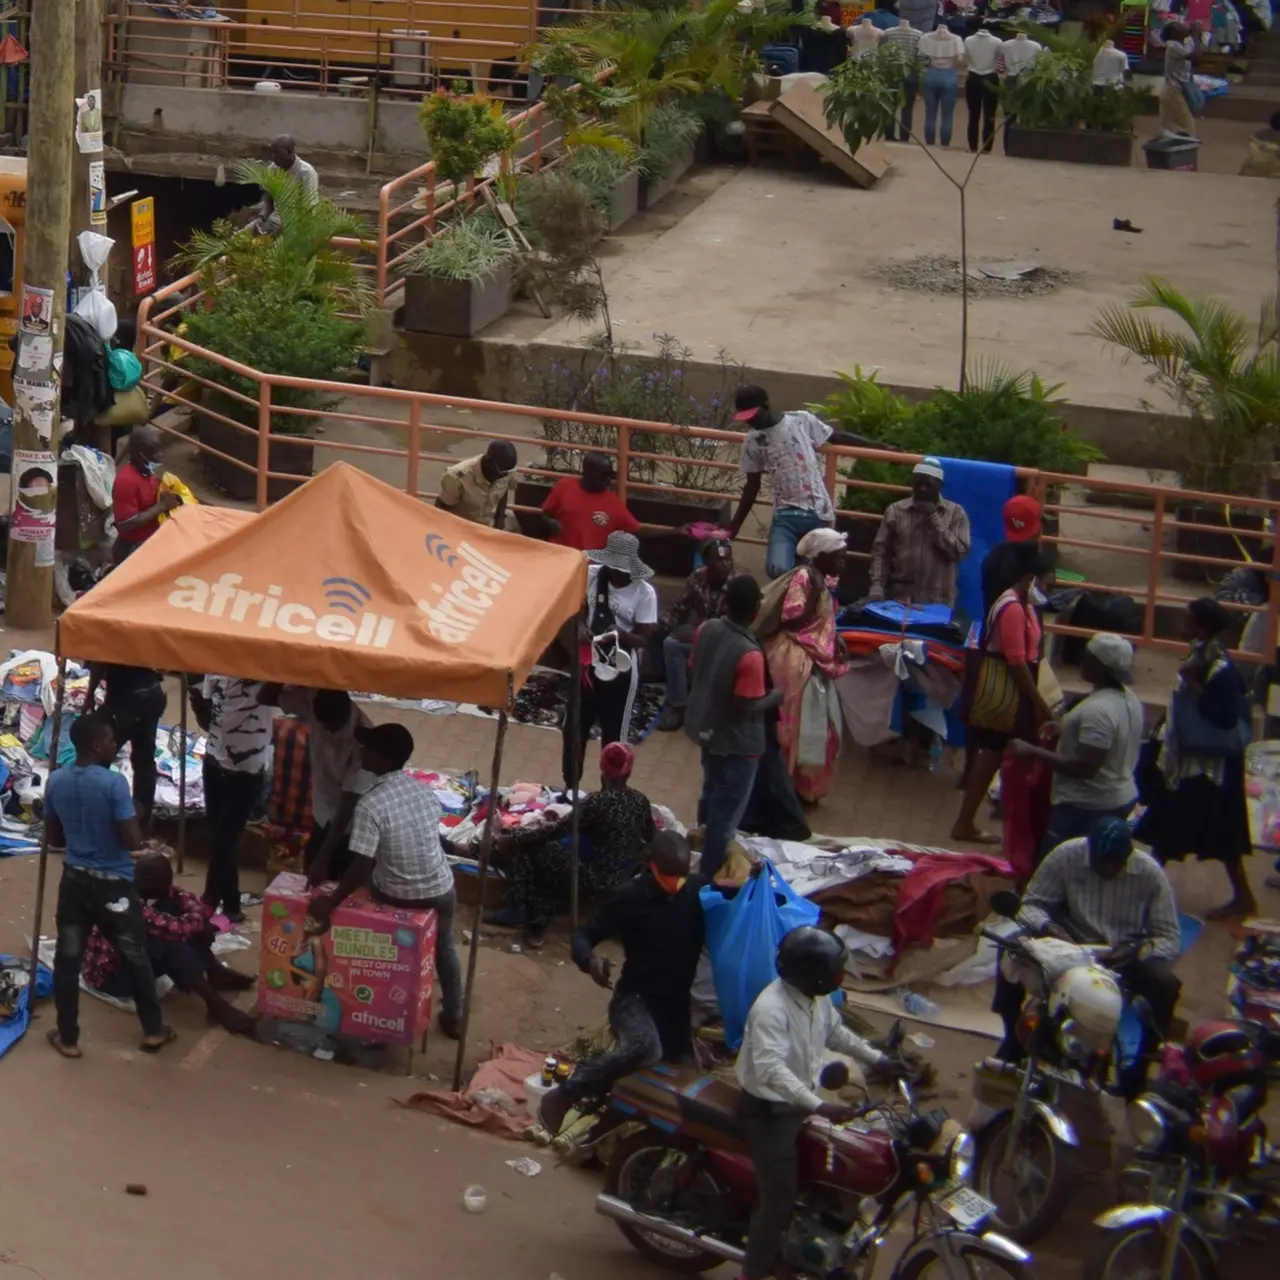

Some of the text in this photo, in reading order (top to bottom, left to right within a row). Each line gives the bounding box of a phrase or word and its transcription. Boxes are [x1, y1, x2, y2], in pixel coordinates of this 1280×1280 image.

[419, 541, 511, 643] africell
[168, 573, 396, 648] africell
[333, 928, 370, 941] MEET
[270, 938, 289, 954] 4G
[335, 943, 397, 960] BUNDLES
[351, 959, 374, 969] BEST
[375, 961, 410, 972] OFFERS
[362, 969, 391, 979] TOWN
[351, 1009, 405, 1032] africell
